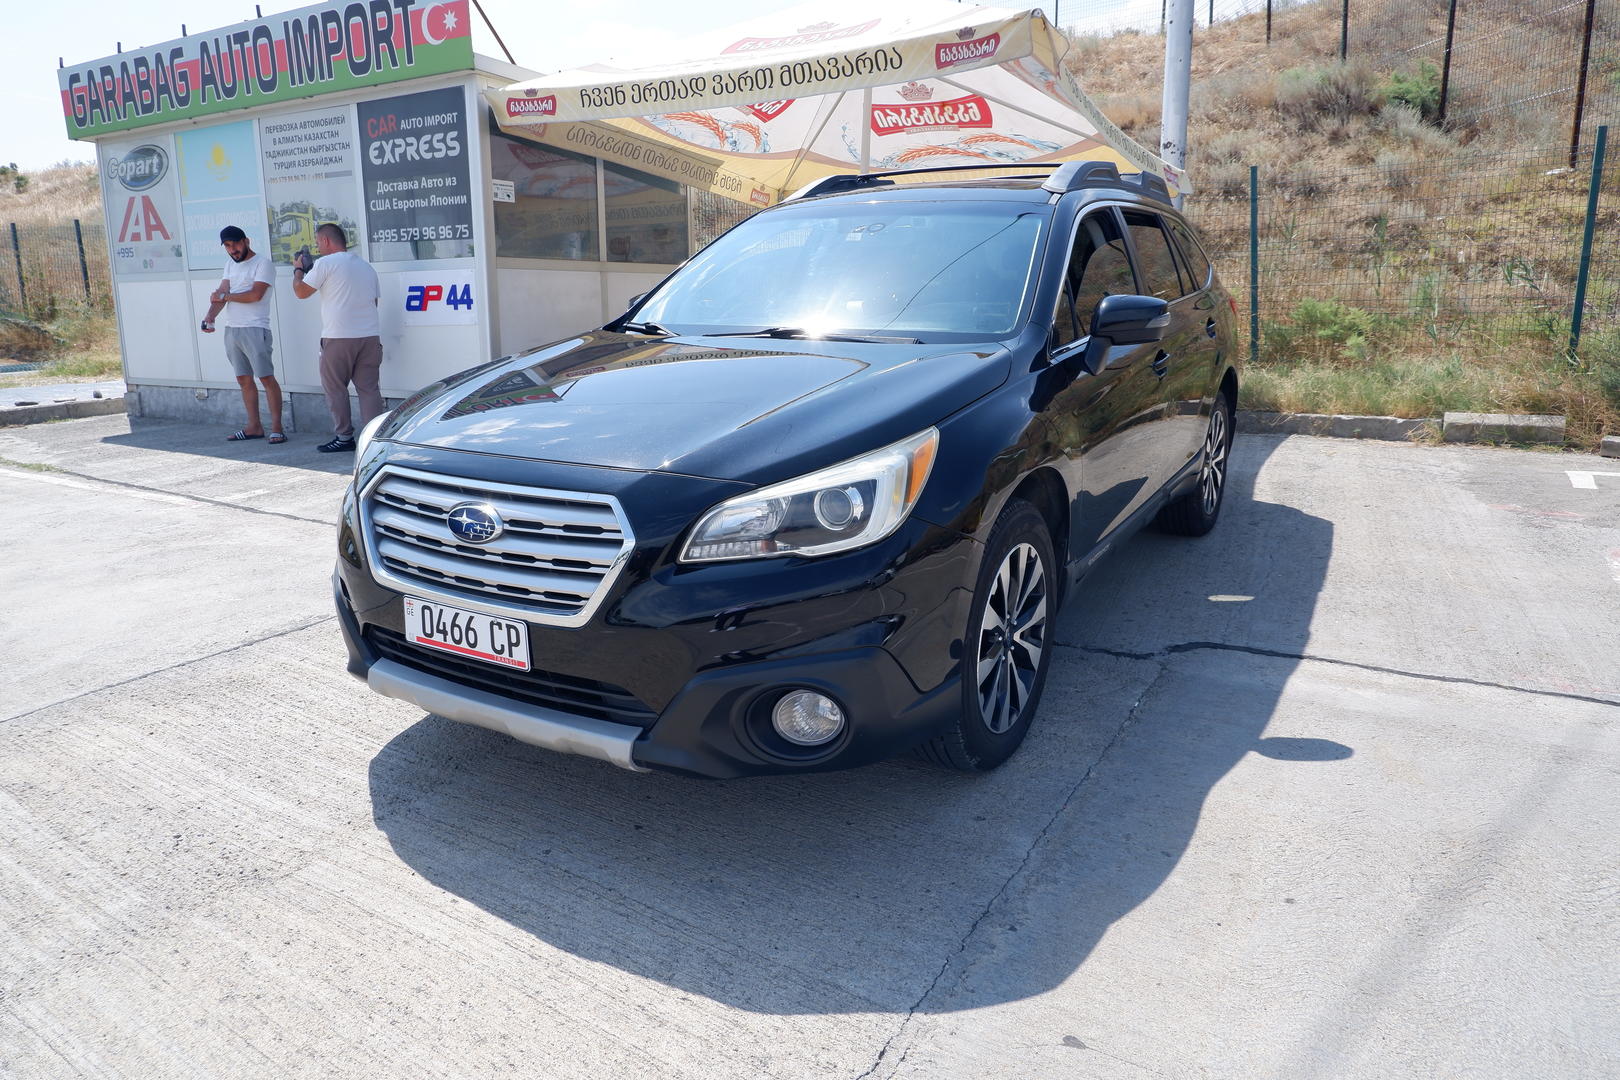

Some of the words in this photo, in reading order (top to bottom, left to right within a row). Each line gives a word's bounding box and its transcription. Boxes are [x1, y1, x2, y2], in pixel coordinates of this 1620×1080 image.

[940, 39, 995, 63] ნატახტარი
[68, 46, 190, 128] GARABAG
[199, 25, 279, 104] AUTO
[282, 0, 416, 88] IMPORT
[579, 84, 625, 109] ჩვენ
[631, 76, 706, 104] ერთად
[712, 67, 774, 96] ვართ
[780, 47, 903, 87] მთავარია
[265, 122, 299, 135] ПЕРЕВОЗКА
[299, 114, 346, 130] АВТОМОБИЛЕЙ
[367, 114, 397, 138] CAR
[400, 117, 423, 131] AUTO
[424, 112, 458, 127] IMPORT
[272, 137, 278, 146] В
[278, 134, 304, 145] АЛМАТЫ
[304, 130, 339, 141] КАЗАХСТАН
[368, 131, 461, 166] EXPRESS
[265, 146, 309, 159] ТАДЖИКИСТАН
[309, 142, 351, 154] КЫРГЫЗСТАН
[107, 153, 160, 181] Copart
[273, 160, 297, 171] ТУРЦИЯ
[297, 155, 343, 168] АЗЕРБАЙДЖАН
[376, 180, 419, 194] Доставка
[420, 176, 444, 190] Авто
[445, 176, 457, 187] из
[370, 199, 392, 211] США
[392, 198, 429, 212] Европы
[430, 194, 467, 207] Японии
[372, 229, 398, 242] +995
[400, 228, 420, 241] 579
[422, 226, 436, 239] 96
[439, 225, 453, 239] 96
[455, 224, 469, 238] 75
[116, 247, 135, 258] +995
[446, 284, 473, 310] 44
[406, 607, 414, 617] GE
[421, 604, 478, 649] 0466
[489, 619, 521, 658] CP
